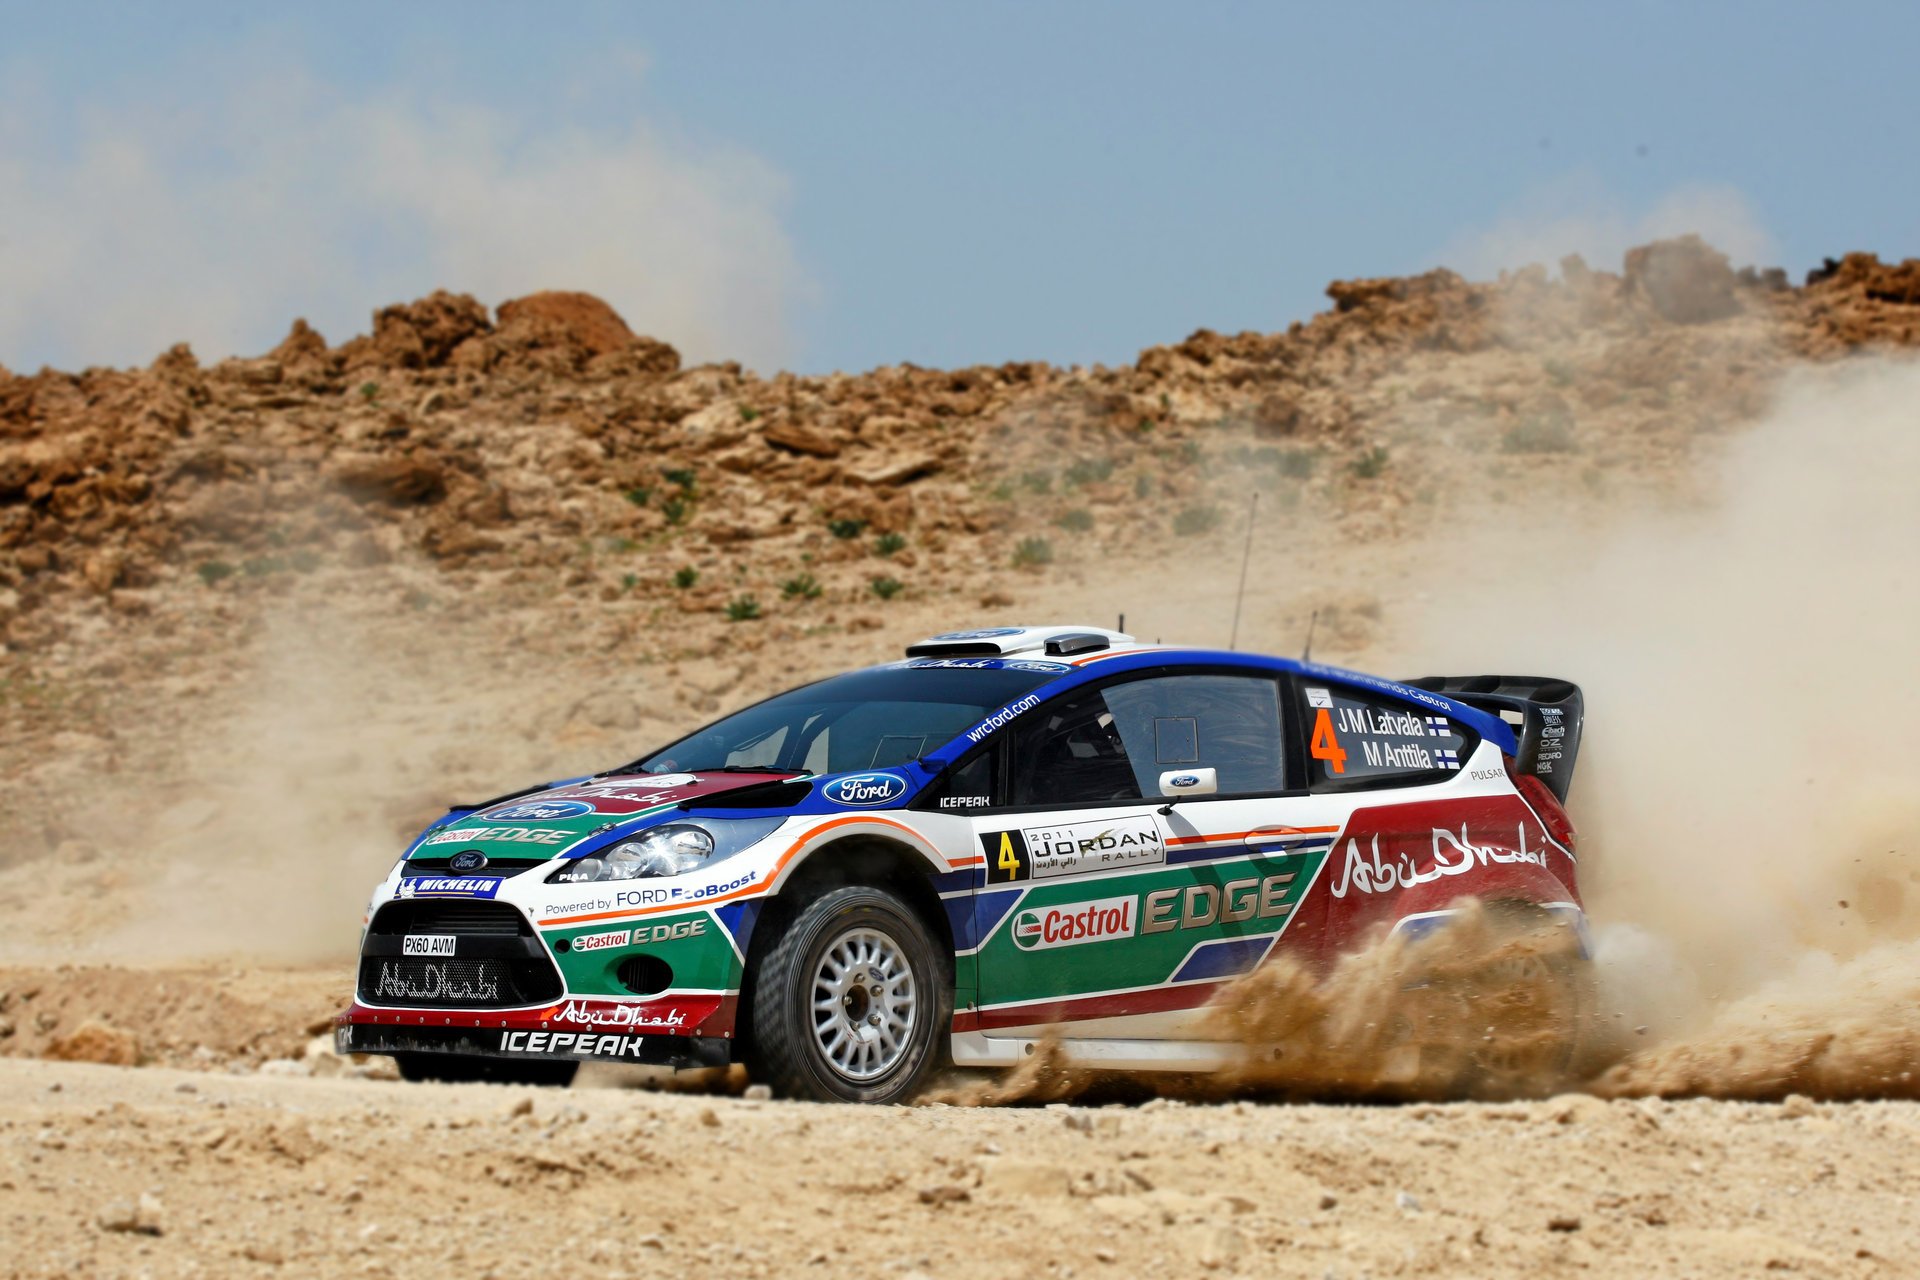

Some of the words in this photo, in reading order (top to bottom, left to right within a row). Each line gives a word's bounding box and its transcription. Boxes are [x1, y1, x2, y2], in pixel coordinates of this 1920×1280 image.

[1408, 690, 1452, 711] Castrol
[966, 693, 1041, 743] wrcford.com
[1338, 708, 1348, 733] J
[1347, 708, 1368, 734] M
[1367, 709, 1425, 737] Latvala
[1310, 708, 1347, 773] 4
[1362, 741, 1383, 766] M
[1386, 744, 1432, 770] Anttila
[1537, 762, 1552, 771] NGK
[1175, 777, 1195, 786] Ford
[1471, 768, 1505, 780] PULSAR
[841, 777, 893, 801] Ford
[494, 803, 577, 819] Ford
[940, 796, 990, 808] ICEPEAK
[480, 828, 578, 845] EDGE
[1031, 830, 1075, 842] 2011
[1034, 830, 1159, 858] JORDAN
[455, 855, 478, 867] Ford
[997, 831, 1021, 881] 4
[1060, 857, 1078, 869] رالي
[1101, 847, 1160, 862] RALLY
[1331, 832, 1434, 899] Abu
[1432, 821, 1547, 877] Dhabi
[418, 879, 497, 892] MICHELIN
[559, 873, 589, 881] PIAA
[545, 899, 595, 915] Powered
[597, 898, 612, 909] by
[616, 889, 668, 906] FORD
[1043, 901, 1130, 944] Castrol
[1140, 872, 1298, 935] EDGE
[586, 933, 627, 949] Castrol
[632, 918, 708, 945] EDGE
[405, 937, 429, 953] PX60
[431, 938, 455, 954] AVM
[375, 962, 425, 997] Abu
[424, 963, 499, 1000] Dhabi
[554, 1000, 614, 1024] Abu
[611, 1004, 687, 1026] Dhabi
[500, 1031, 644, 1058] ICEPEAK
